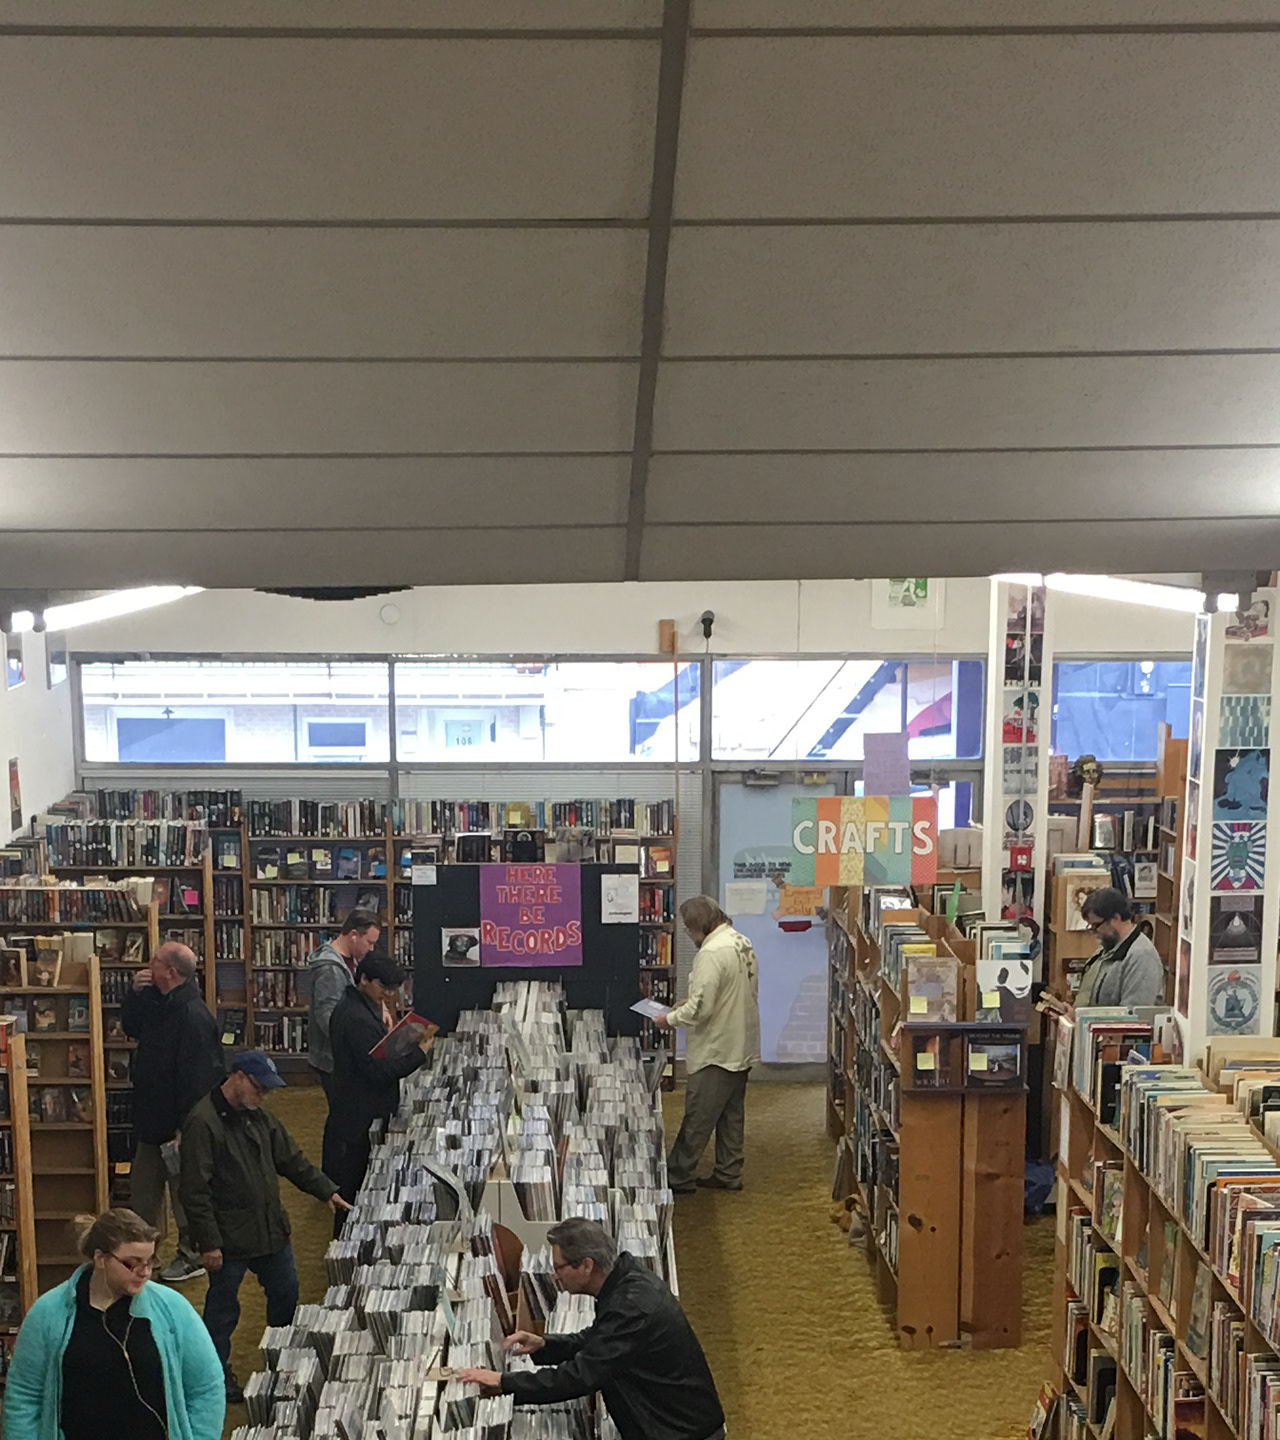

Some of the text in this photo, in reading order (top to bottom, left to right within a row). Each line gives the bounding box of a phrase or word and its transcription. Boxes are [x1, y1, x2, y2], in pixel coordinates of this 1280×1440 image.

[792, 820, 935, 856] CRAFTS
[506, 865, 558, 884] HERE
[496, 885, 562, 904] THERE
[520, 906, 546, 925] BE
[481, 919, 582, 955] RECORDS
